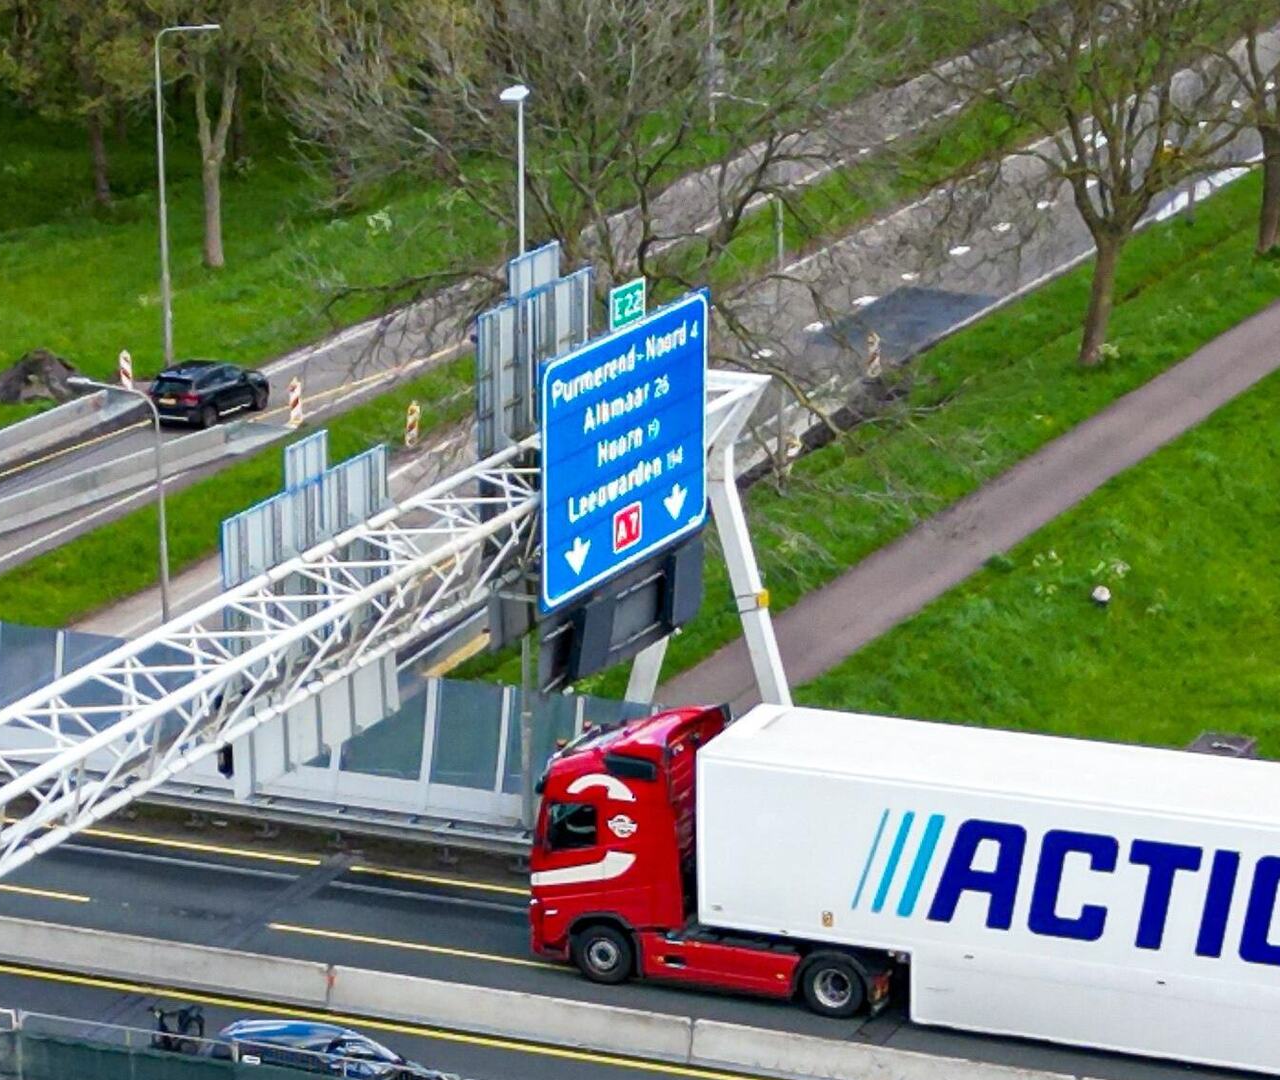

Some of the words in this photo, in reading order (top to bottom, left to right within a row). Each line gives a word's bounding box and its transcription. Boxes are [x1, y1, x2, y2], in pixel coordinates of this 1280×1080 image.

[613, 289, 642, 321] E22
[690, 319, 699, 339] 4
[585, 382, 650, 434] Alkmaar
[653, 374, 670, 398] 26
[597, 427, 644, 467] Hoorn
[568, 456, 663, 523] Leeuwarden
[617, 511, 639, 541] A7
